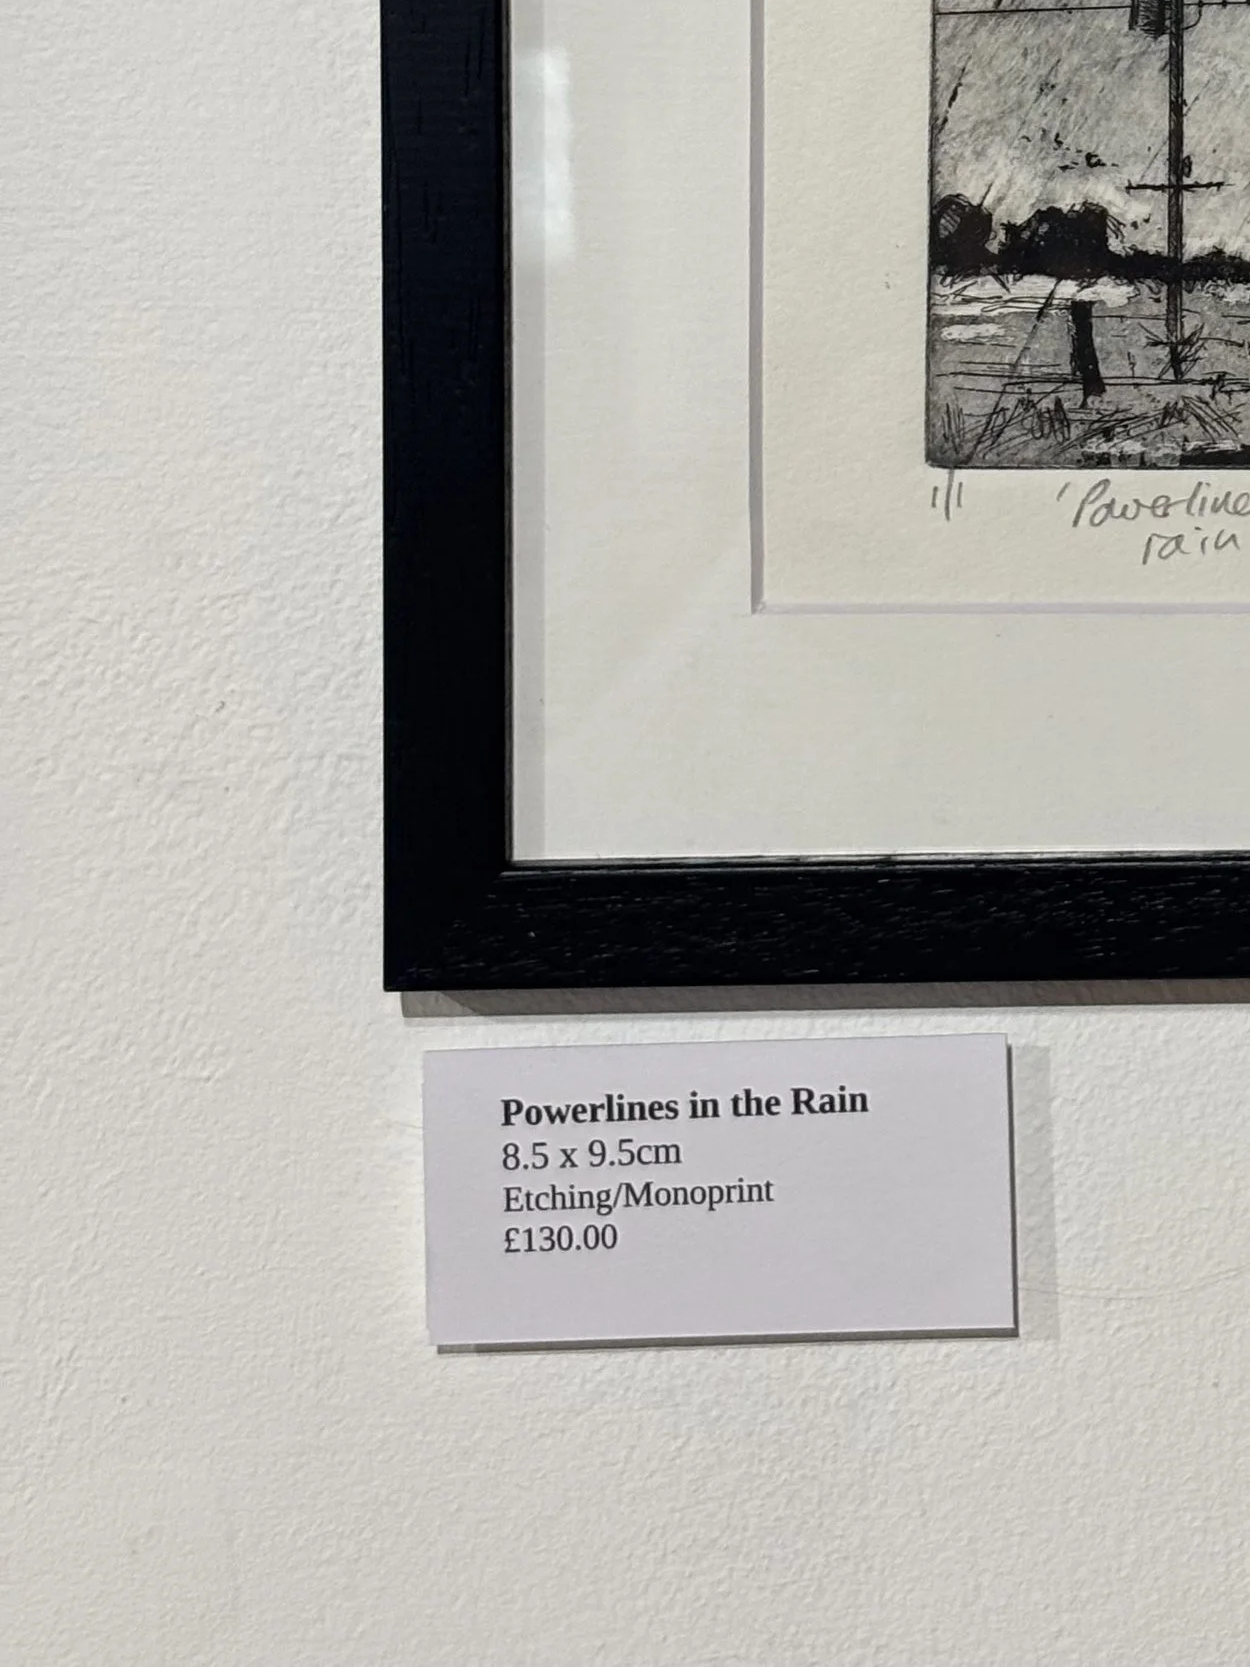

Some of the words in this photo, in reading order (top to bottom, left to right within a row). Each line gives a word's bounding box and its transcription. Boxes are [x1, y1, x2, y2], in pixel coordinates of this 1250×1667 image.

[1142, 526, 1240, 566] rain
[501, 1093, 679, 1126] Powerlines
[689, 1091, 720, 1120] in
[731, 1088, 782, 1118] the
[790, 1086, 869, 1116] Rain
[502, 1142, 549, 1171] 8.5
[559, 1148, 579, 1169] x
[587, 1139, 682, 1168] 9.5cm
[503, 1179, 775, 1216] Etching/Monoprint
[503, 1224, 618, 1254] £130.00
